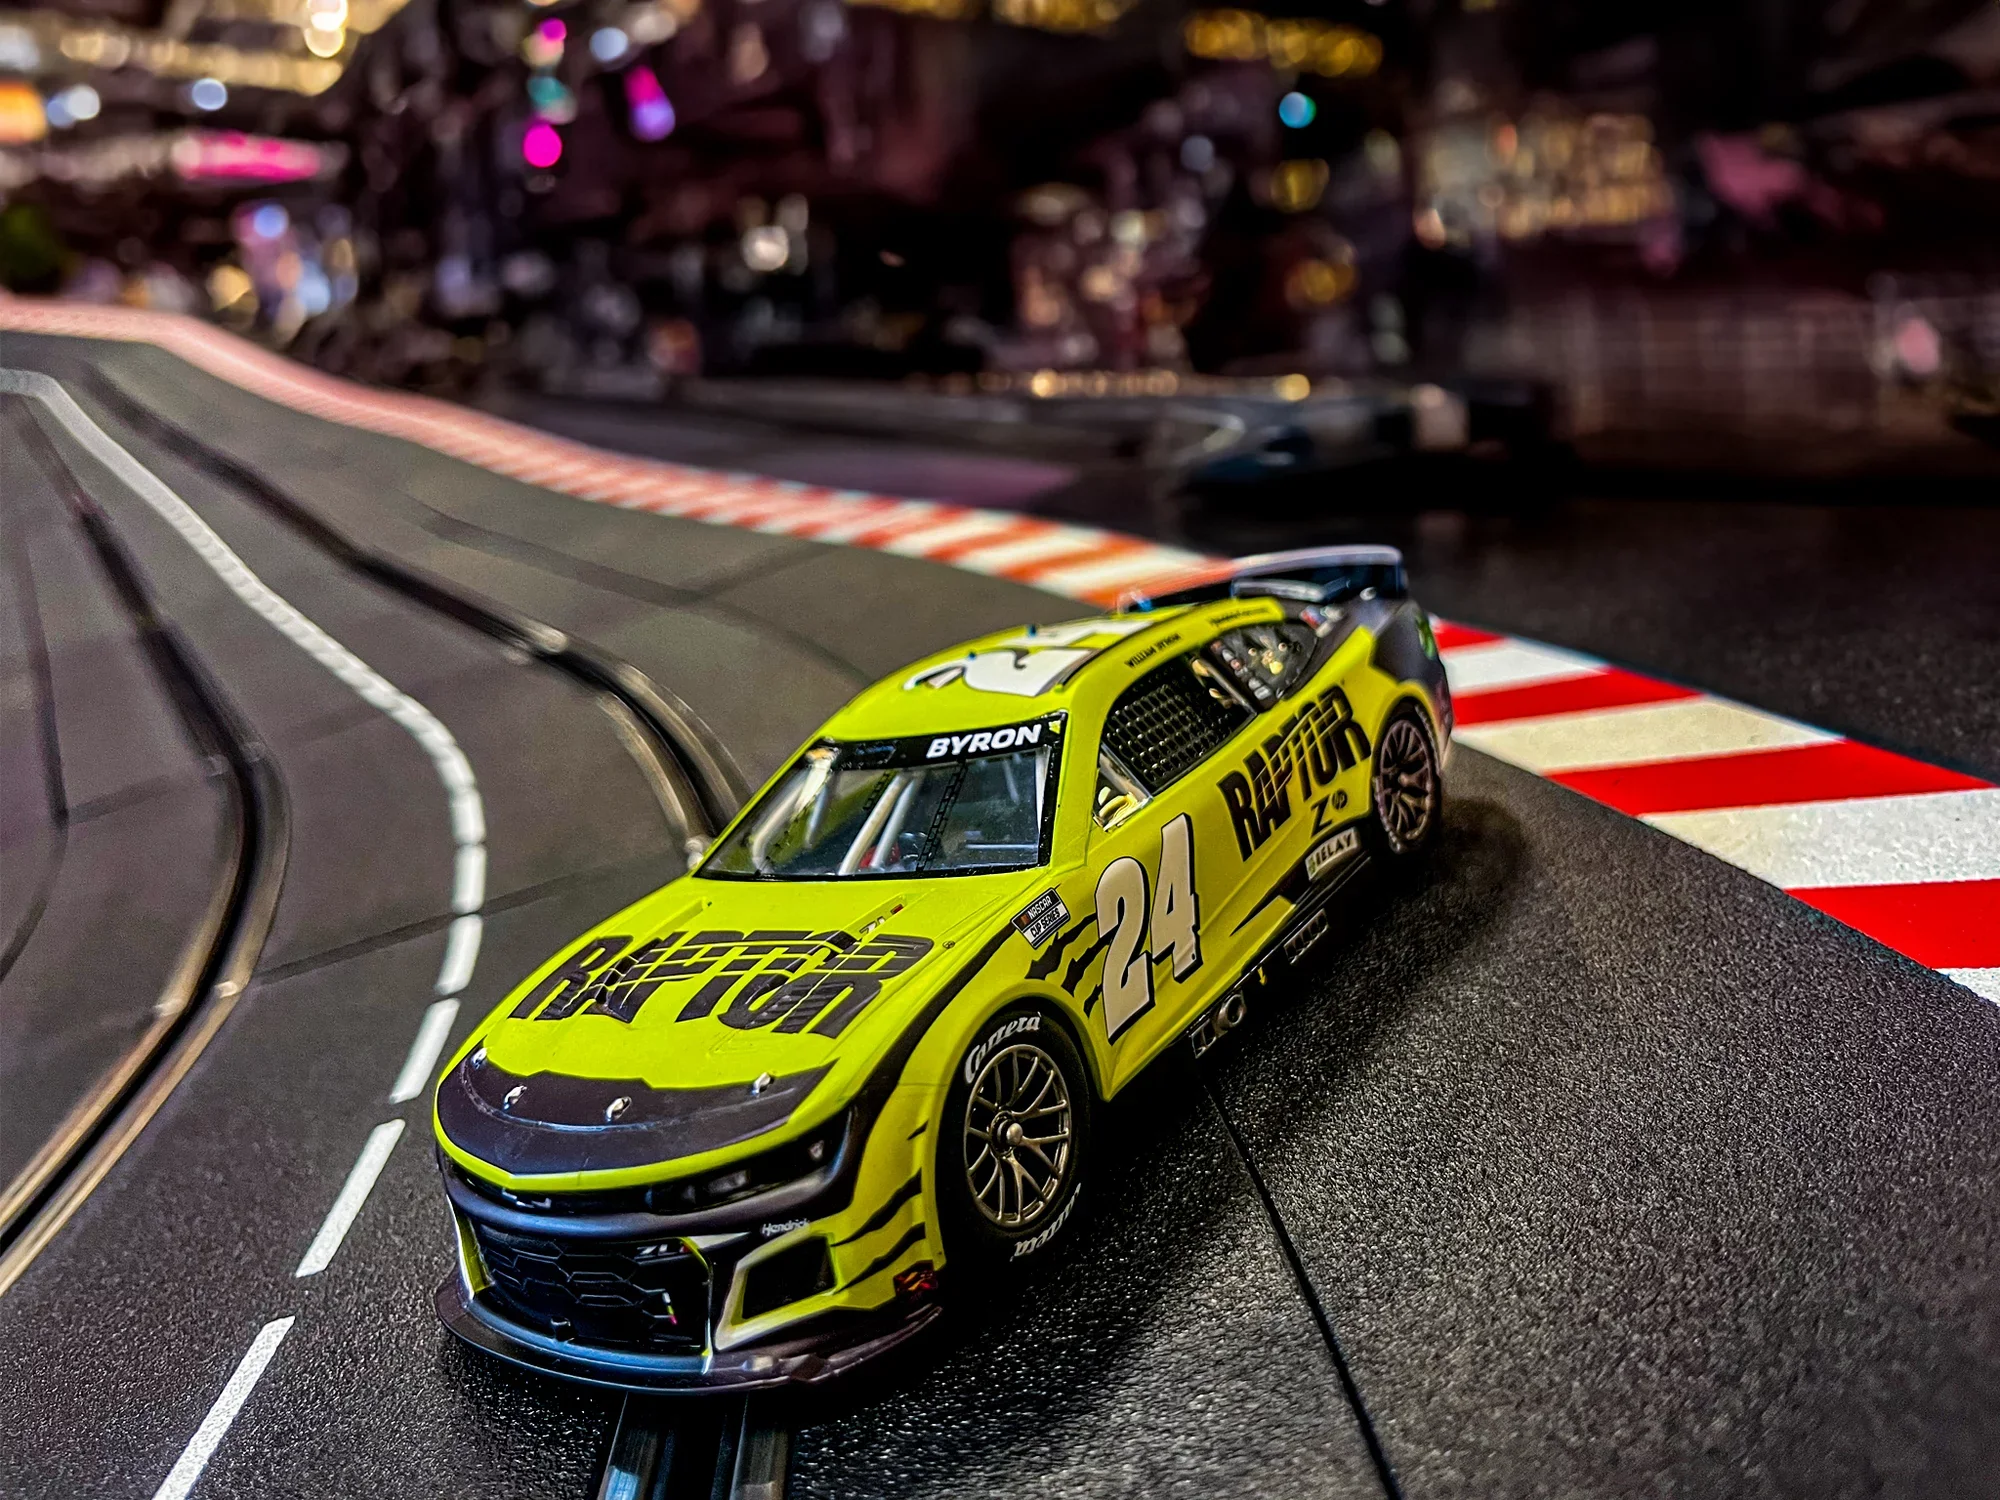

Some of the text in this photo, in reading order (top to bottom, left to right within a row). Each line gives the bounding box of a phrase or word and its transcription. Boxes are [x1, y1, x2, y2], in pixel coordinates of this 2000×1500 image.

[1124, 647, 1158, 668] WILLIAM
[926, 724, 1042, 759] BYRON
[1216, 686, 1372, 862] RAPTOR
[1311, 794, 1333, 838] Z
[1027, 896, 1053, 919] NASCAR
[1030, 907, 1061, 938] CUP SERIES
[1094, 812, 1203, 1045] 24
[508, 930, 935, 1038] RAPTOR
[964, 1012, 1042, 1084] Carrera
